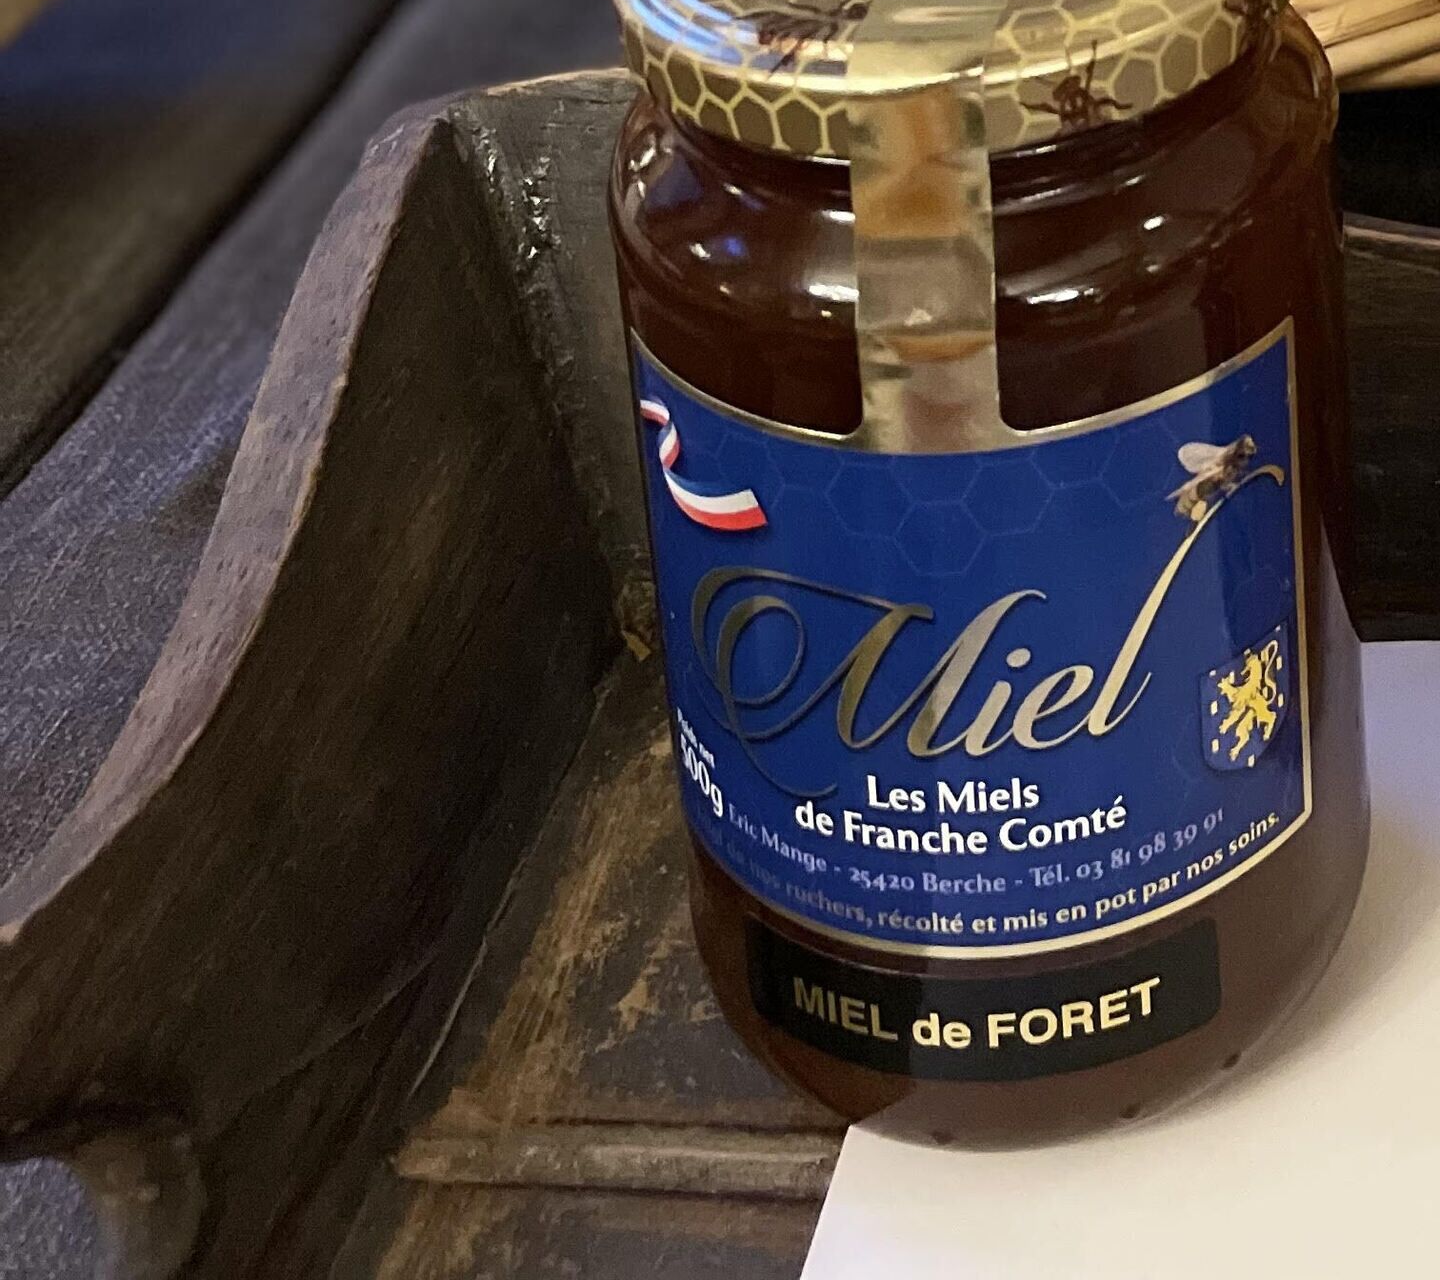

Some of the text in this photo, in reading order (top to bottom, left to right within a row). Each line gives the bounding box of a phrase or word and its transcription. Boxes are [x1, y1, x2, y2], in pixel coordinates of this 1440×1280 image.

[691, 463, 1285, 798] Miel
[680, 732, 724, 818] 500g
[866, 774, 1040, 814] Les Miels
[727, 802, 759, 840] Eric
[760, 824, 828, 873] Mange
[848, 864, 915, 892] 25420
[922, 871, 1007, 895] Berche
[1028, 865, 1071, 888] Tél.
[1074, 858, 1105, 882] 03
[1110, 847, 1132, 871] 81
[1138, 831, 1168, 866] 98
[1172, 822, 1199, 853] 39
[1203, 806, 1225, 835] 91
[794, 794, 1128, 855] de Franche Comté
[878, 906, 964, 935] récolté
[971, 912, 997, 934] et
[1003, 901, 1049, 932] mis
[1055, 900, 1088, 924] en
[1095, 886, 1137, 921] pot
[1142, 869, 1180, 905] par
[1186, 848, 1224, 881] nos
[1228, 810, 1281, 857] soins.
[792, 975, 1161, 1049] MIEL de FORET
